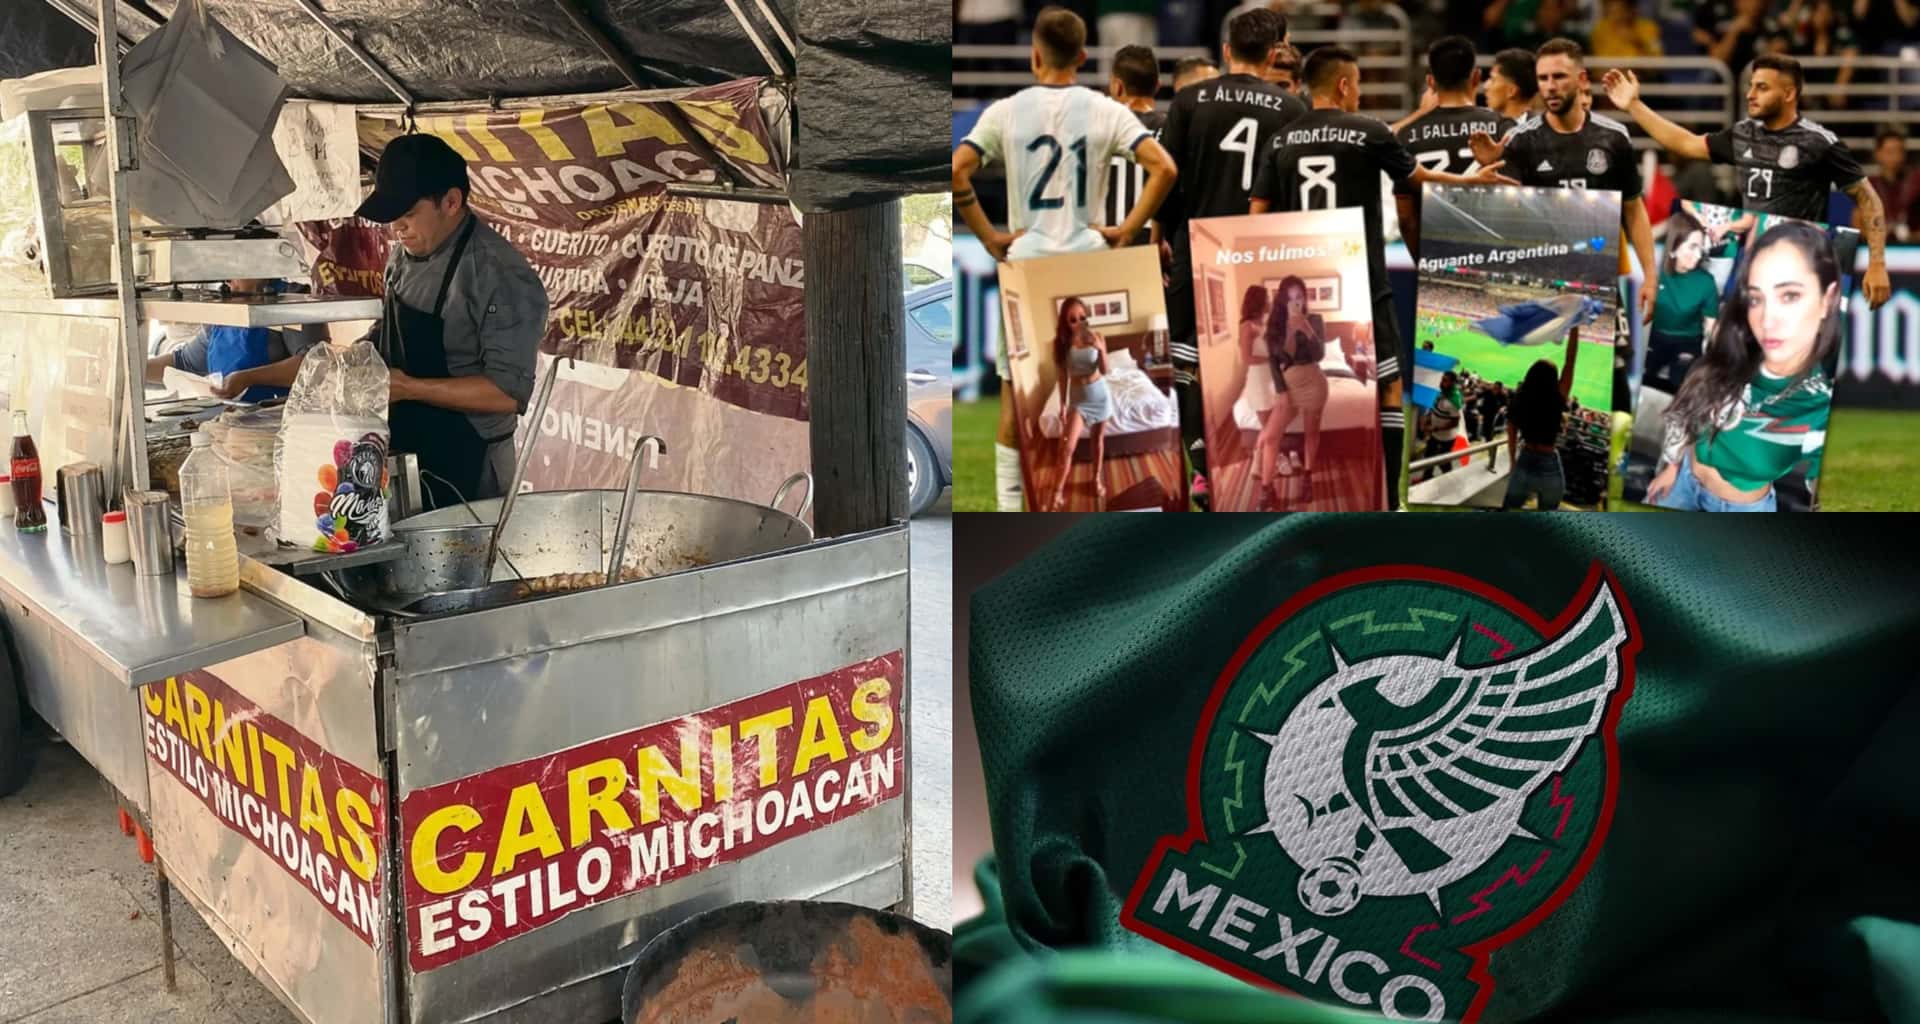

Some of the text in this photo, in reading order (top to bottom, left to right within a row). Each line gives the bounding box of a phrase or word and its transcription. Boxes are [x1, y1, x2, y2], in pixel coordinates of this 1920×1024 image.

[1215, 86, 1283, 112] ÁLVAREZ
[1286, 124, 1368, 147] RODRÍGUEZ
[1026, 134, 1088, 211] 21
[1219, 117, 1259, 191] 4
[1298, 155, 1337, 211] 8
[1747, 167, 1773, 199] 29
[530, 264, 611, 295] URTIDA
[410, 677, 895, 896] CARNITAS
[147, 713, 381, 947] ESTILO MICHOACAN
[416, 748, 897, 958] ESTILO MICHOACAN
[1152, 867, 1446, 1023] MEXICO
